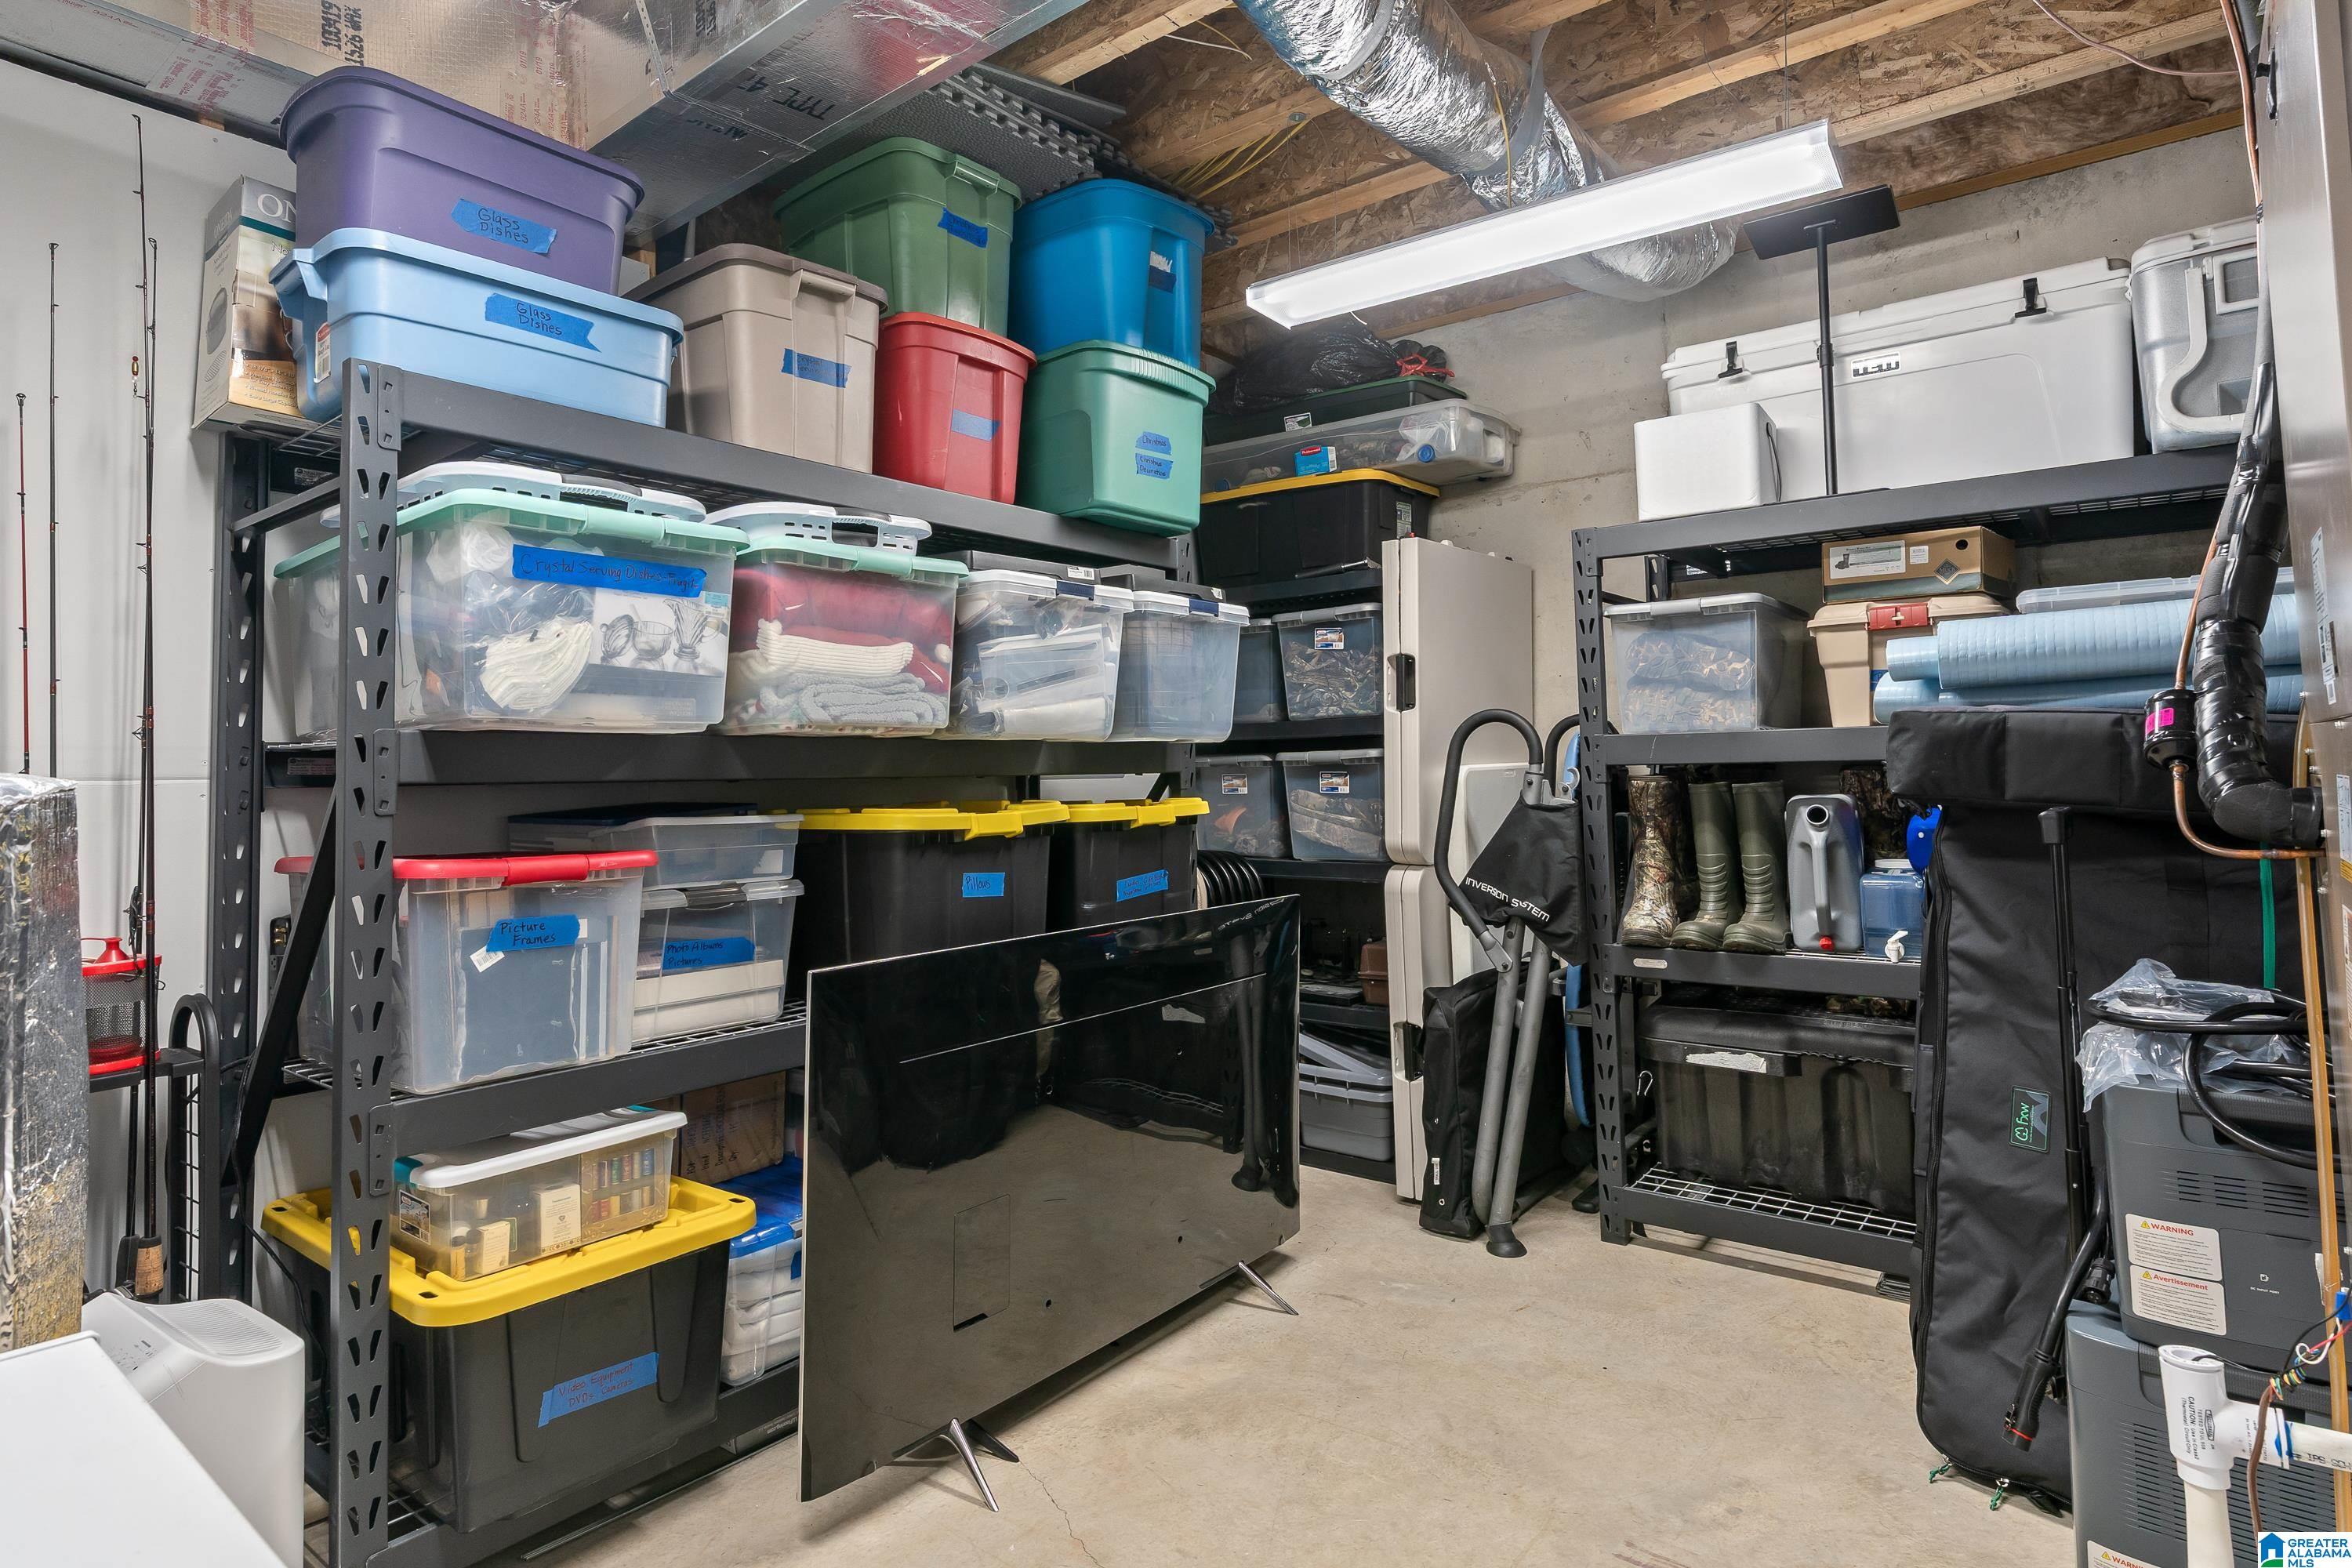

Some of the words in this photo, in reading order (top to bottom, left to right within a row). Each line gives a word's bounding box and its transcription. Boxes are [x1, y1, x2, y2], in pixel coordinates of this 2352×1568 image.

[519, 51, 528, 69] 01/19
[771, 86, 836, 121] TYPE
[478, 208, 520, 230] Glass
[480, 222, 529, 244] Dishes
[516, 303, 552, 321] Glass
[518, 314, 563, 336] Dishes
[521, 554, 574, 578] Crystal
[579, 562, 622, 582] Serving
[500, 922, 546, 935] Picture
[513, 933, 557, 946] Frames
[667, 942, 689, 953] Photo
[691, 941, 723, 952] Albums
[668, 956, 702, 967] Pictures
[2151, 1222, 2194, 1236] WARNING
[2153, 1273, 2209, 1290] Avertissement
[558, 1380, 586, 1398] Video
[590, 1362, 633, 1386] Equipment
[2187, 1396, 2196, 1426] CAUTION:
